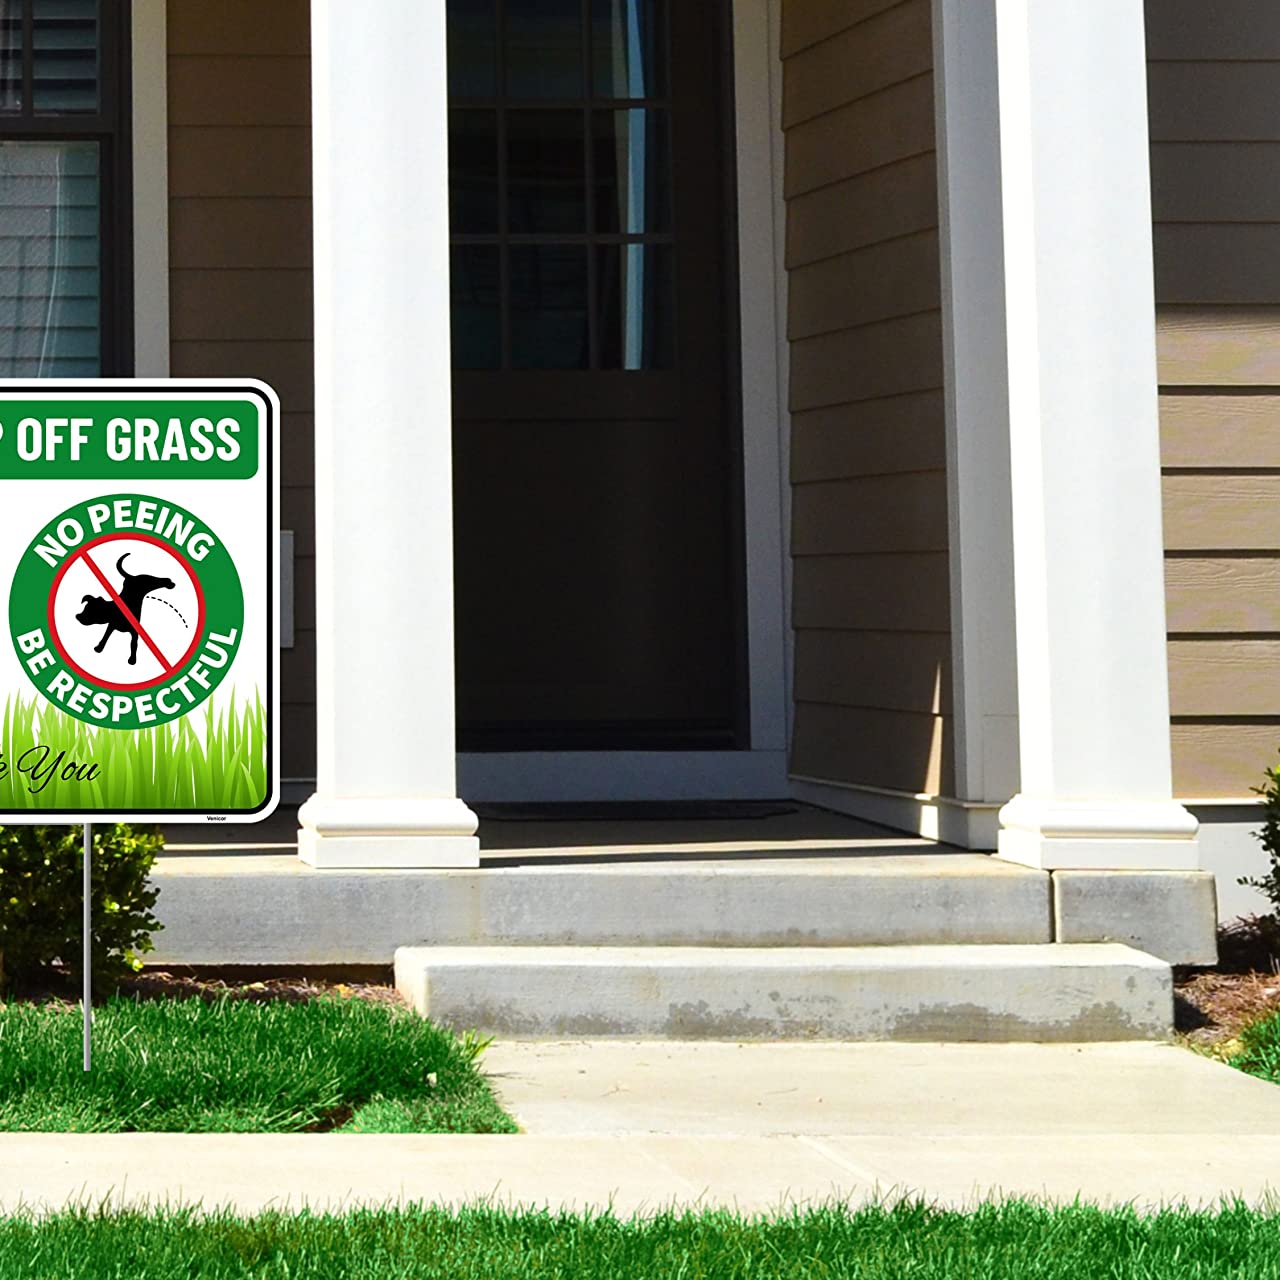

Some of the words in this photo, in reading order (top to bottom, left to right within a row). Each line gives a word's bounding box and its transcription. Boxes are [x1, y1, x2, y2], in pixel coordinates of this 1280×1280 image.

[17, 417, 93, 461] OFF
[106, 416, 241, 461] GRASS
[33, 517, 85, 568] NO
[87, 499, 216, 562] PEEING
[16, 628, 56, 676] BE
[46, 625, 238, 723] RESPECTFUL
[16, 745, 101, 794] You
